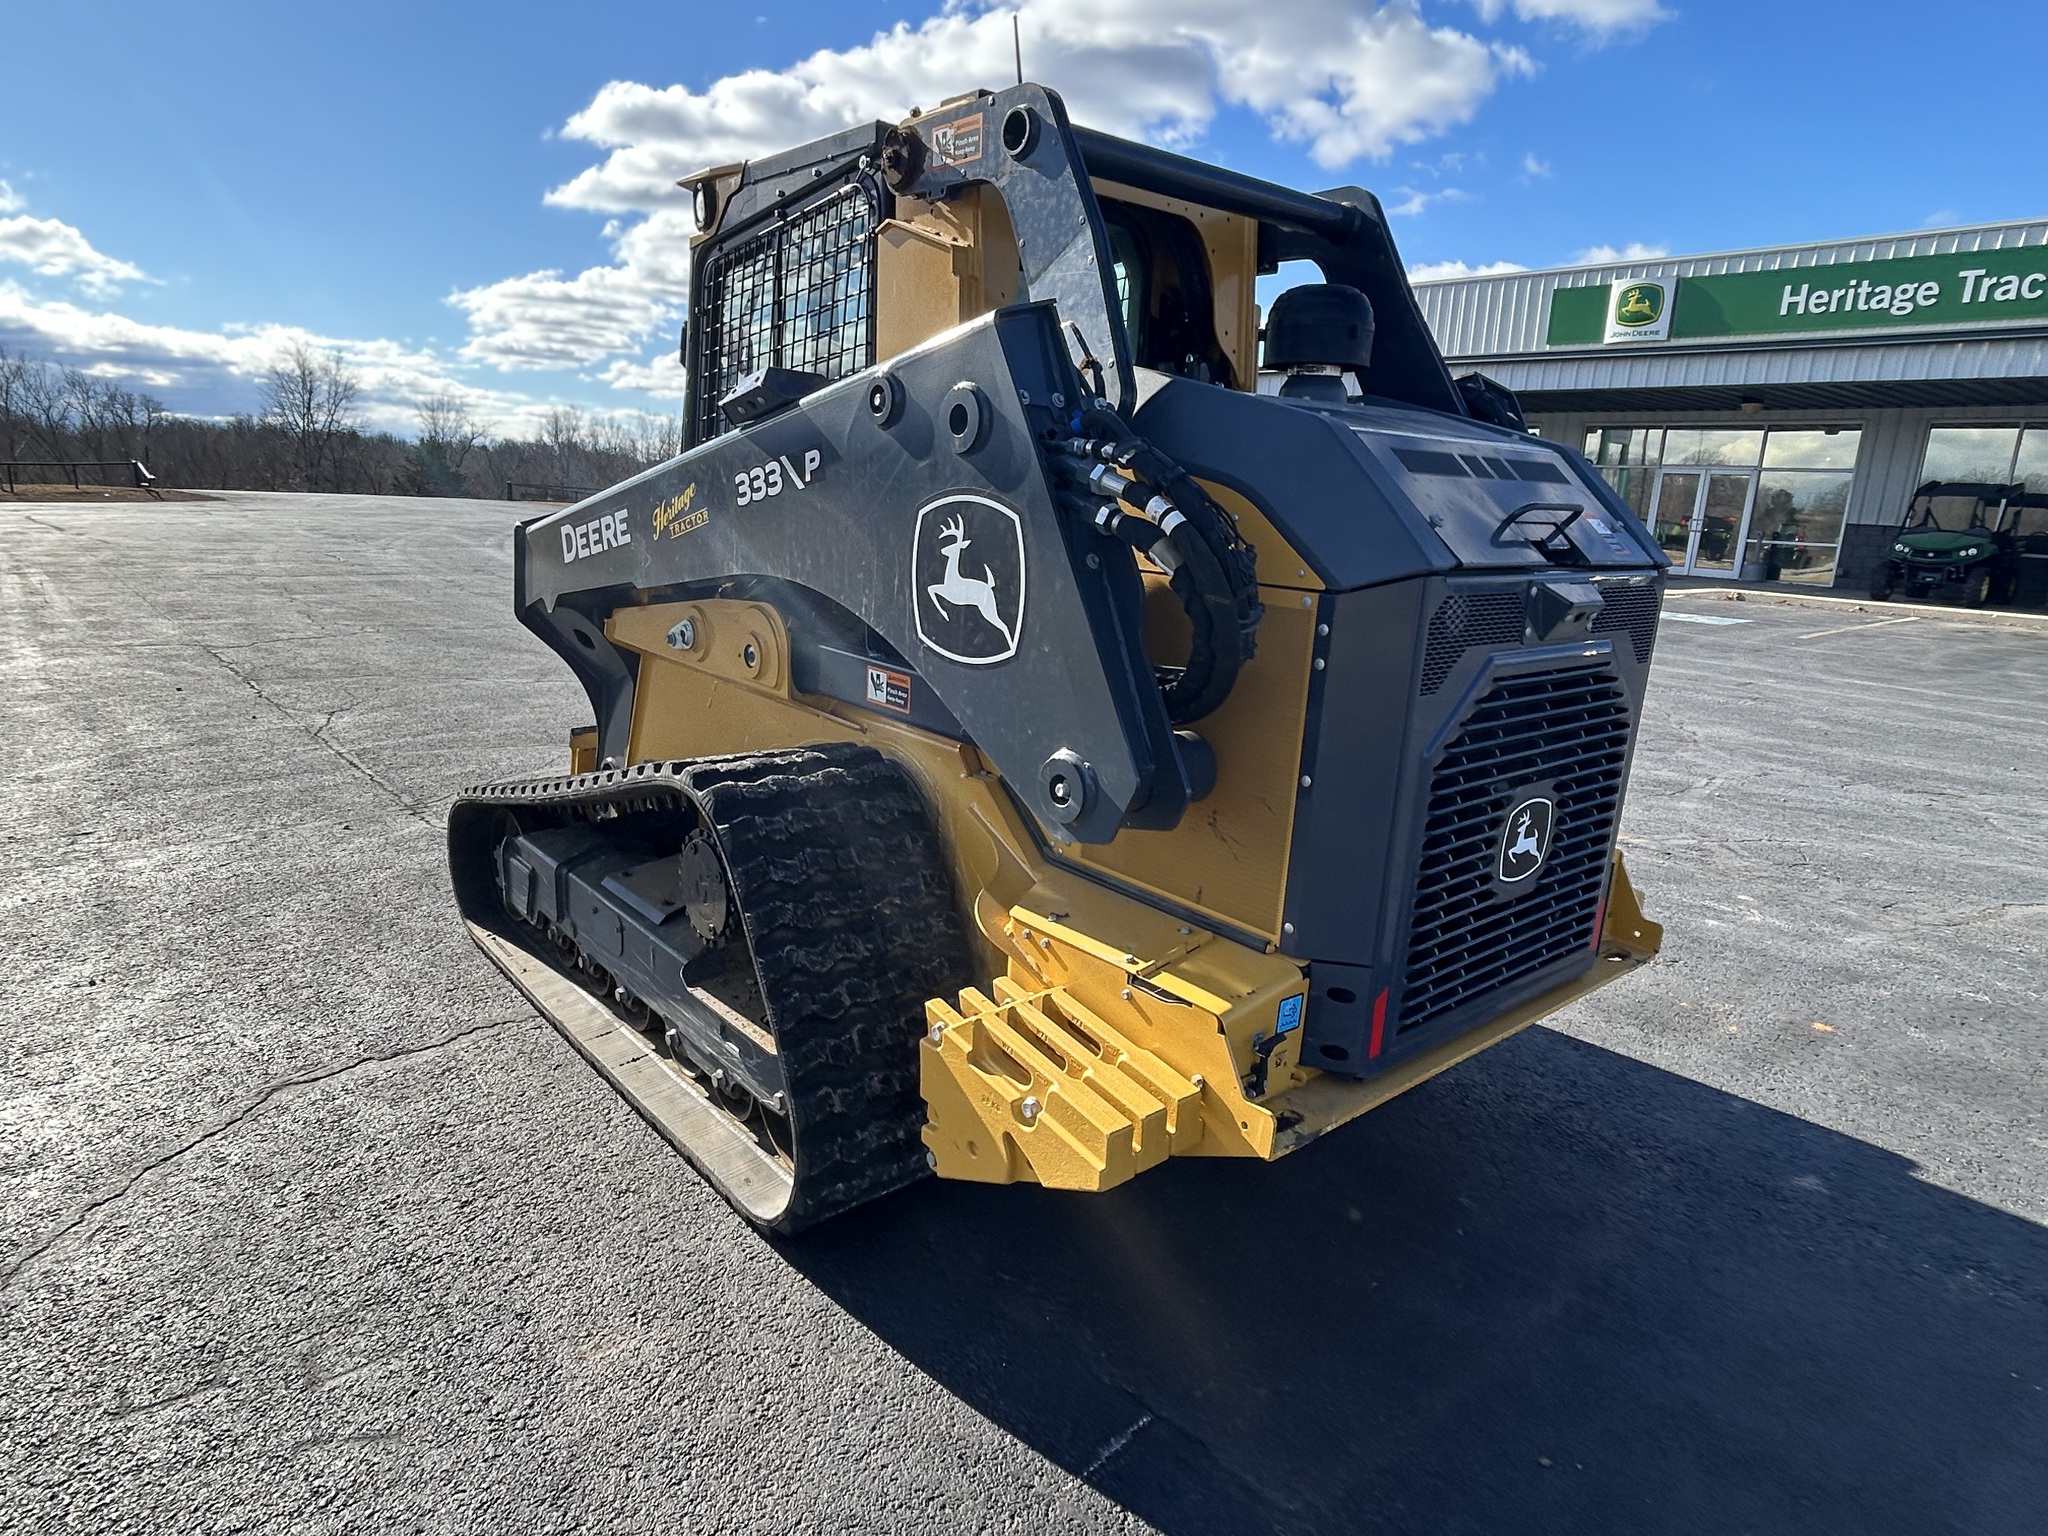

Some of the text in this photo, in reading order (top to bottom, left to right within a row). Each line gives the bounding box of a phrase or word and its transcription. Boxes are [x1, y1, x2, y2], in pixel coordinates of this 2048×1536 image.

[1779, 269, 2047, 316] Heritage Trac
[1610, 329, 1661, 338] JOHN DEERE
[652, 482, 697, 541] Heritage
[669, 510, 710, 536] TRACTOR
[560, 508, 632, 564] DEERE
